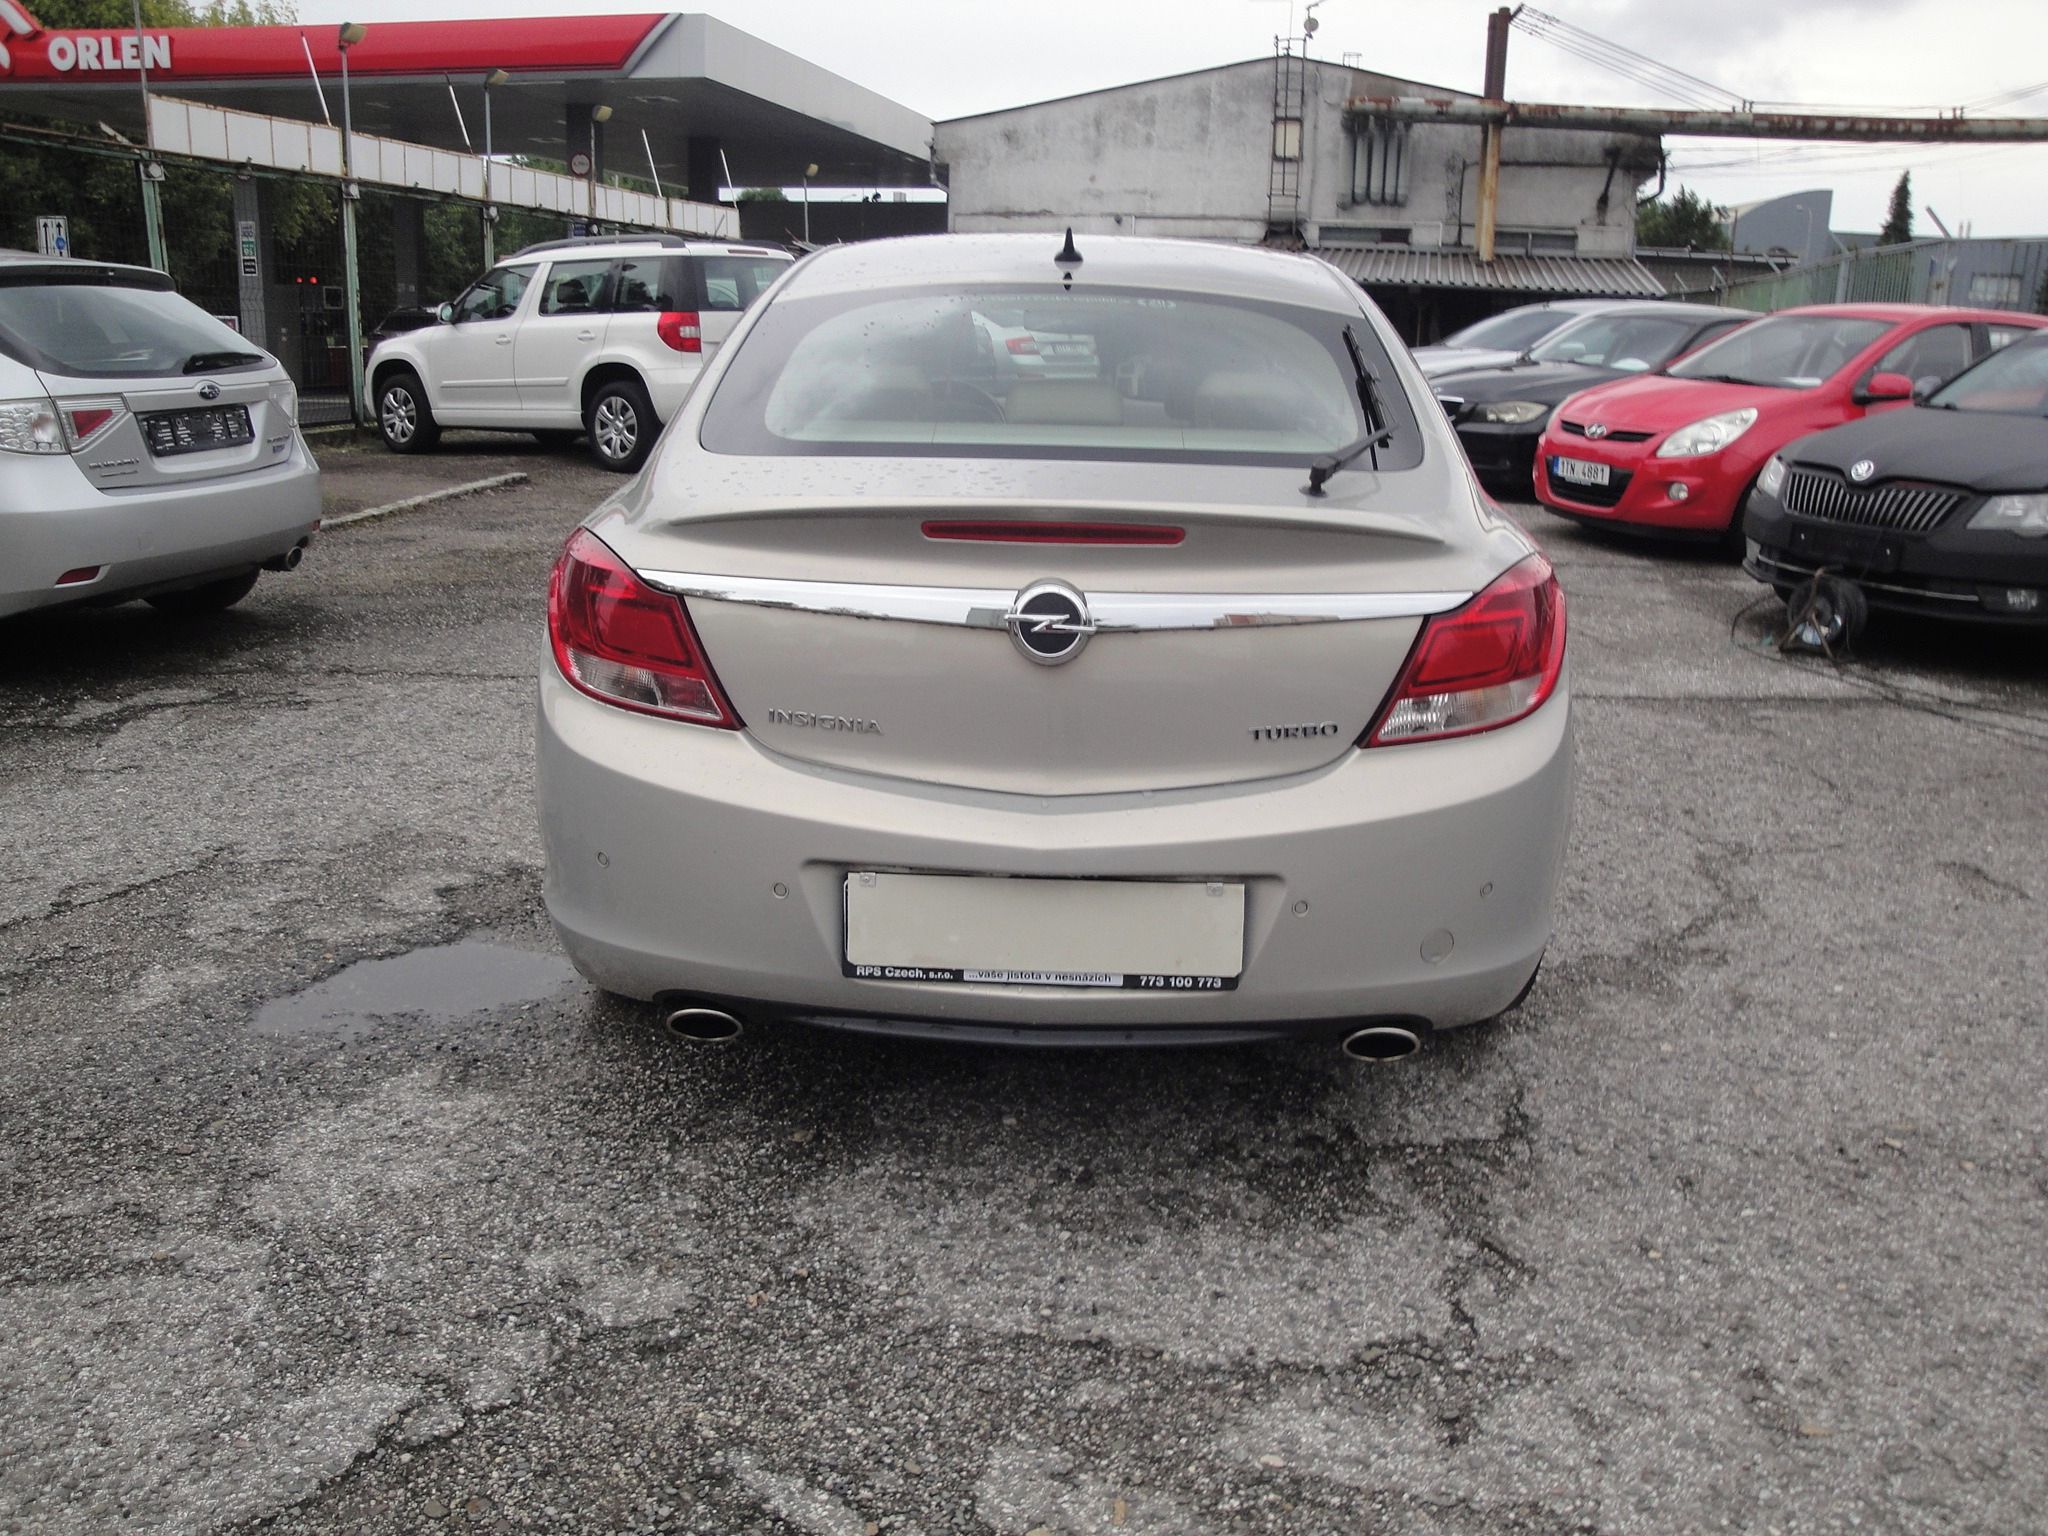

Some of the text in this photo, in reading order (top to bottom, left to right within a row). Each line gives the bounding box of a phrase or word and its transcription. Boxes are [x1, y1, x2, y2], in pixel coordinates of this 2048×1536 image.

[48, 35, 172, 71] ORLEN
[1582, 463, 1605, 481] 4881
[768, 708, 884, 736] INSIGNIA
[1248, 721, 1338, 741] TURBO
[856, 966, 954, 980] RPS Czech, s.r.o.
[1140, 975, 1222, 989] 773 100 773
